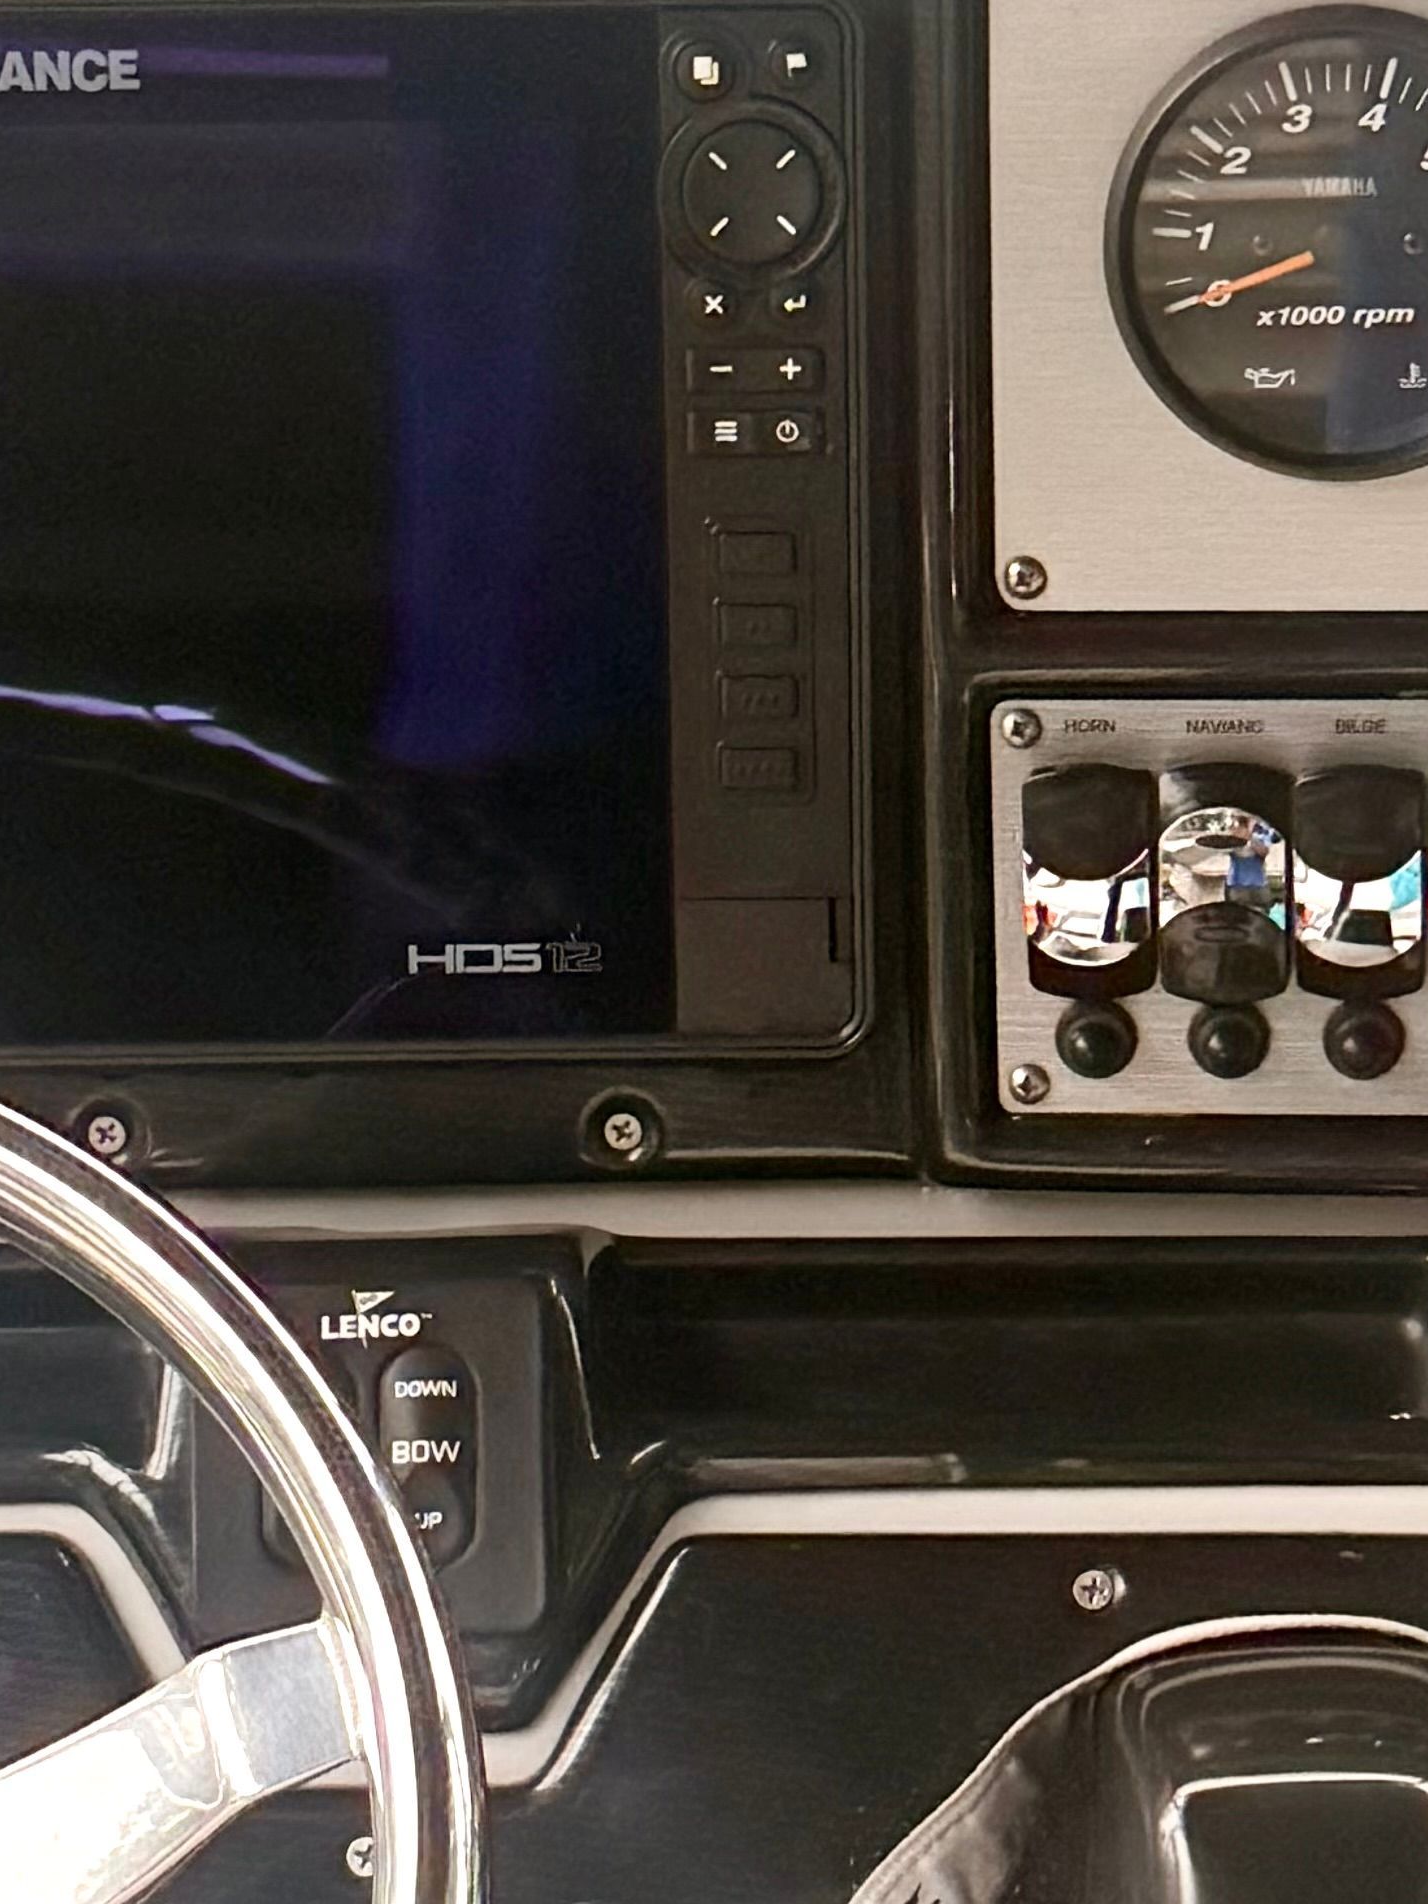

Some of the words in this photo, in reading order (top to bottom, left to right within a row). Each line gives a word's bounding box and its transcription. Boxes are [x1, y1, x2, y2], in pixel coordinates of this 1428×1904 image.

[1281, 104, 1313, 134] 3
[1358, 103, 1388, 133] 4
[1220, 146, 1252, 174] 2
[1301, 176, 1378, 197] YAMAHA
[1195, 222, 1214, 251] 1
[1256, 306, 1346, 327] x1000
[1352, 306, 1415, 329] rpm
[1064, 718, 1117, 734] HORN
[1335, 718, 1387, 734] BILGE
[394, 1380, 458, 1398] DOWN
[391, 1440, 461, 1464] BOW
